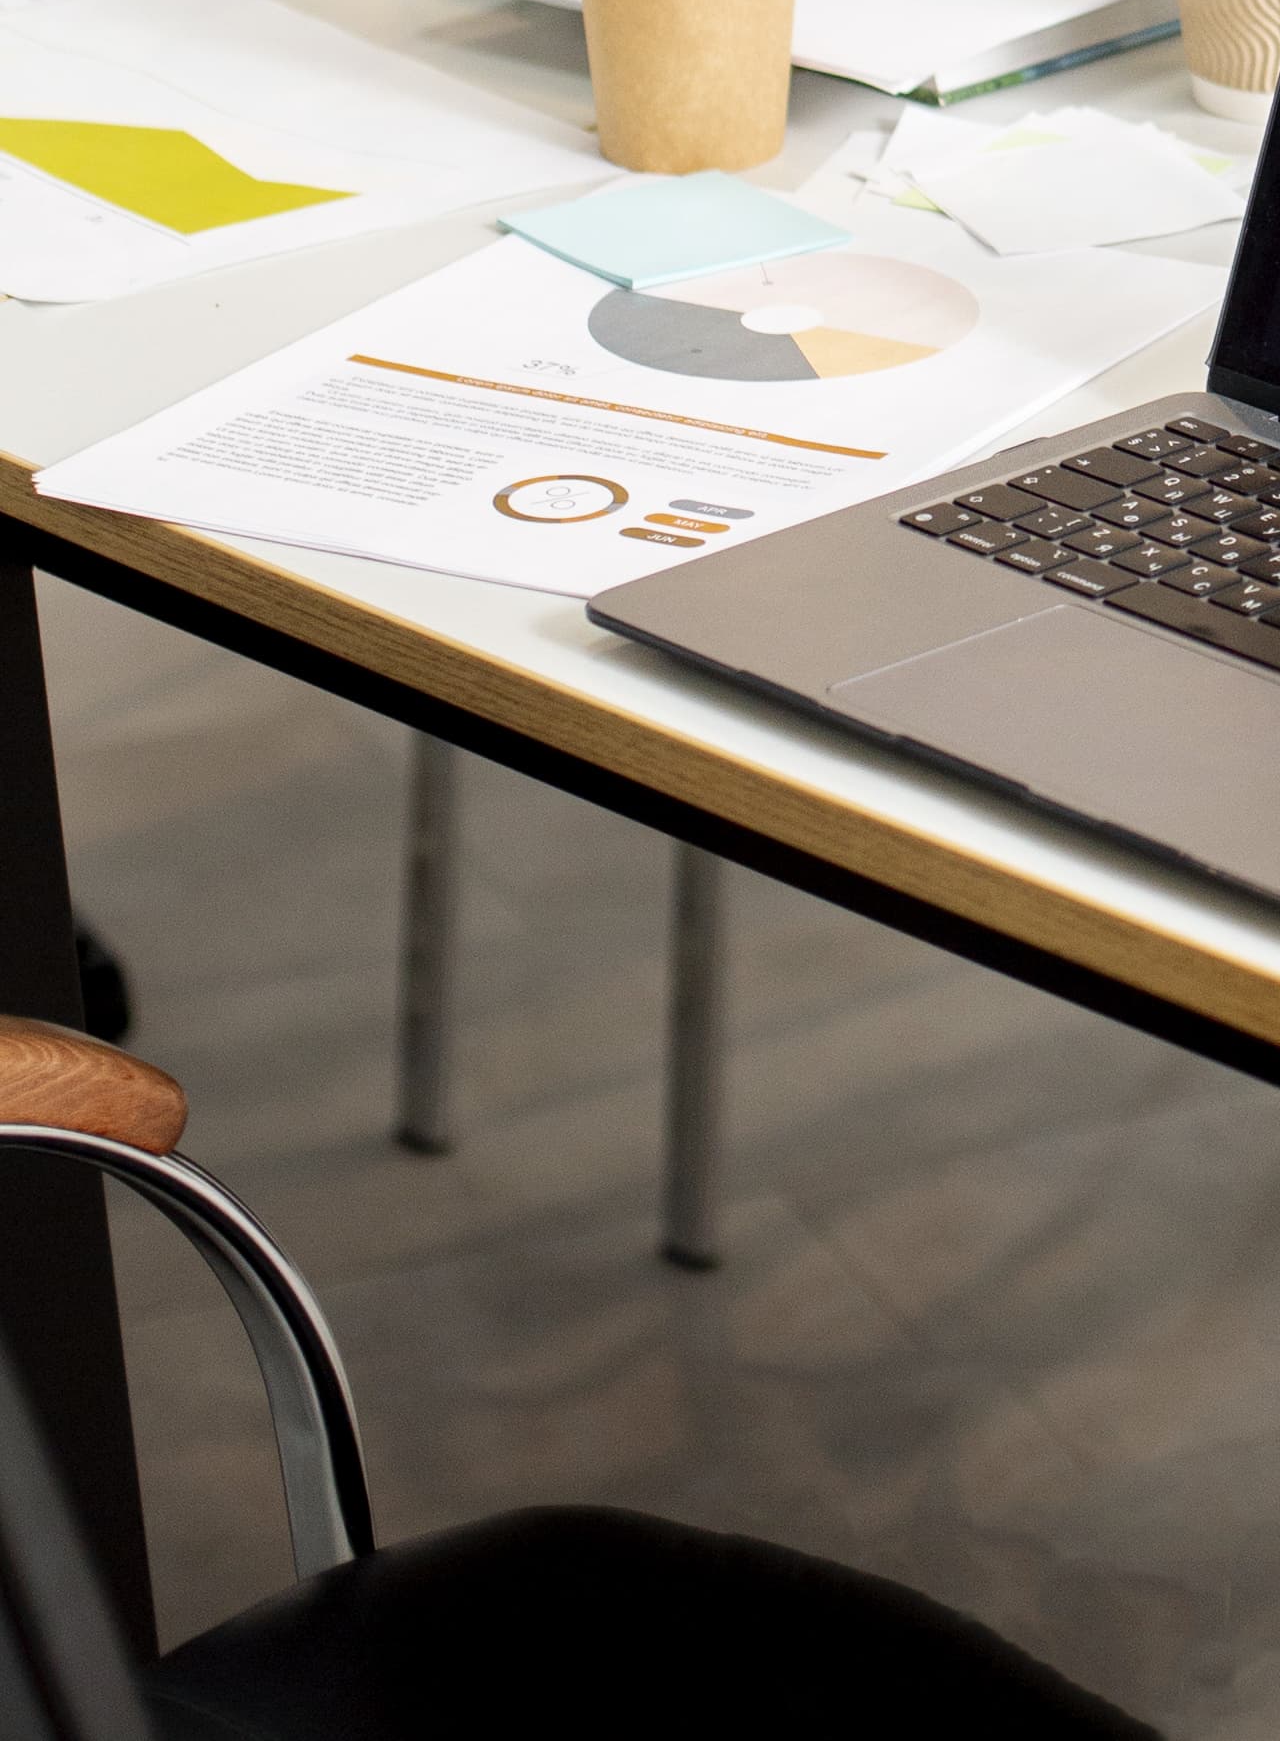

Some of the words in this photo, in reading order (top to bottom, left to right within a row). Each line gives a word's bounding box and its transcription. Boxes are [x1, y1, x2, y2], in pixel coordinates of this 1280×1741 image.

[521, 358, 581, 376] 37%
[1163, 477, 1181, 487] Q
[1223, 473, 1240, 482] 2
[1164, 490, 1185, 500] Й
[1212, 493, 1233, 504] W
[697, 505, 729, 515] APR
[1121, 501, 1139, 510] A
[1213, 509, 1233, 519] Ц
[1259, 512, 1278, 522] E
[673, 518, 704, 529] MAY
[1171, 518, 1189, 527] S
[1092, 528, 1112, 538] Z
[1262, 527, 1280, 535] У
[646, 533, 678, 544] JUN
[959, 533, 996, 549] control
[1219, 536, 1237, 546] D
[1094, 544, 1114, 553] Я
[1141, 547, 1161, 557] X
[1010, 552, 1041, 567] option
[1221, 551, 1240, 560] В
[1148, 562, 1163, 572] Ч
[1191, 566, 1209, 576] C
[1056, 571, 1105, 591] command
[1193, 581, 1211, 591] С
[1243, 584, 1261, 594] V
[1241, 599, 1262, 610] М
